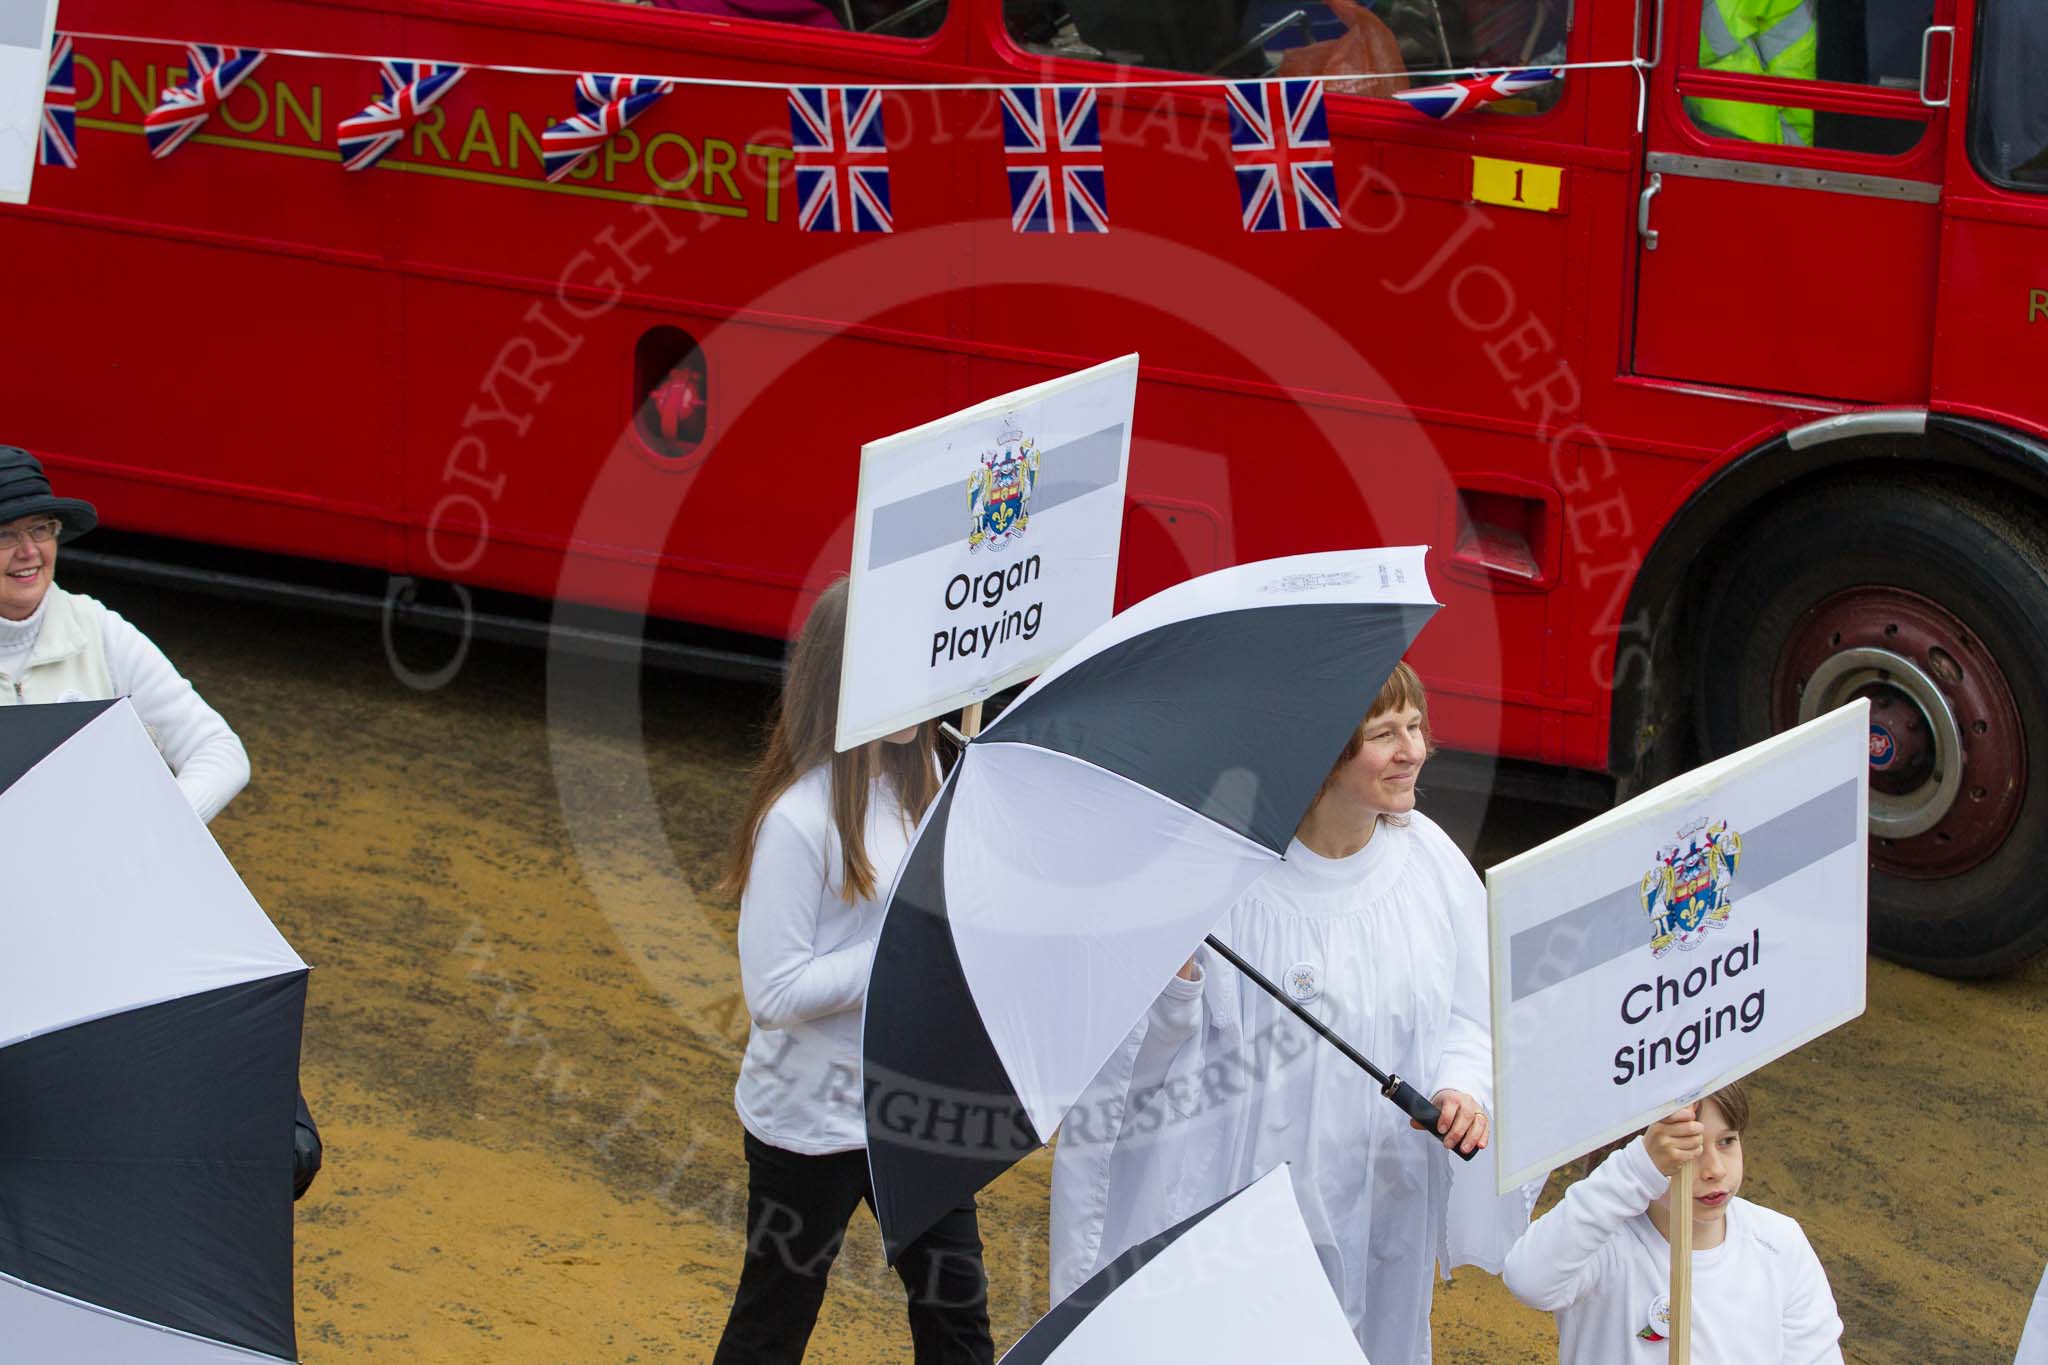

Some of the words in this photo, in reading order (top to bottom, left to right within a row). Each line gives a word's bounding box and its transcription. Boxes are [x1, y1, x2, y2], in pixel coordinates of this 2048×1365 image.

[1512, 168, 1525, 203] 1
[945, 554, 1040, 611] Organ
[931, 601, 1042, 667] Playing
[1620, 928, 1759, 1025] Choral
[1613, 988, 1766, 1086] Singing
